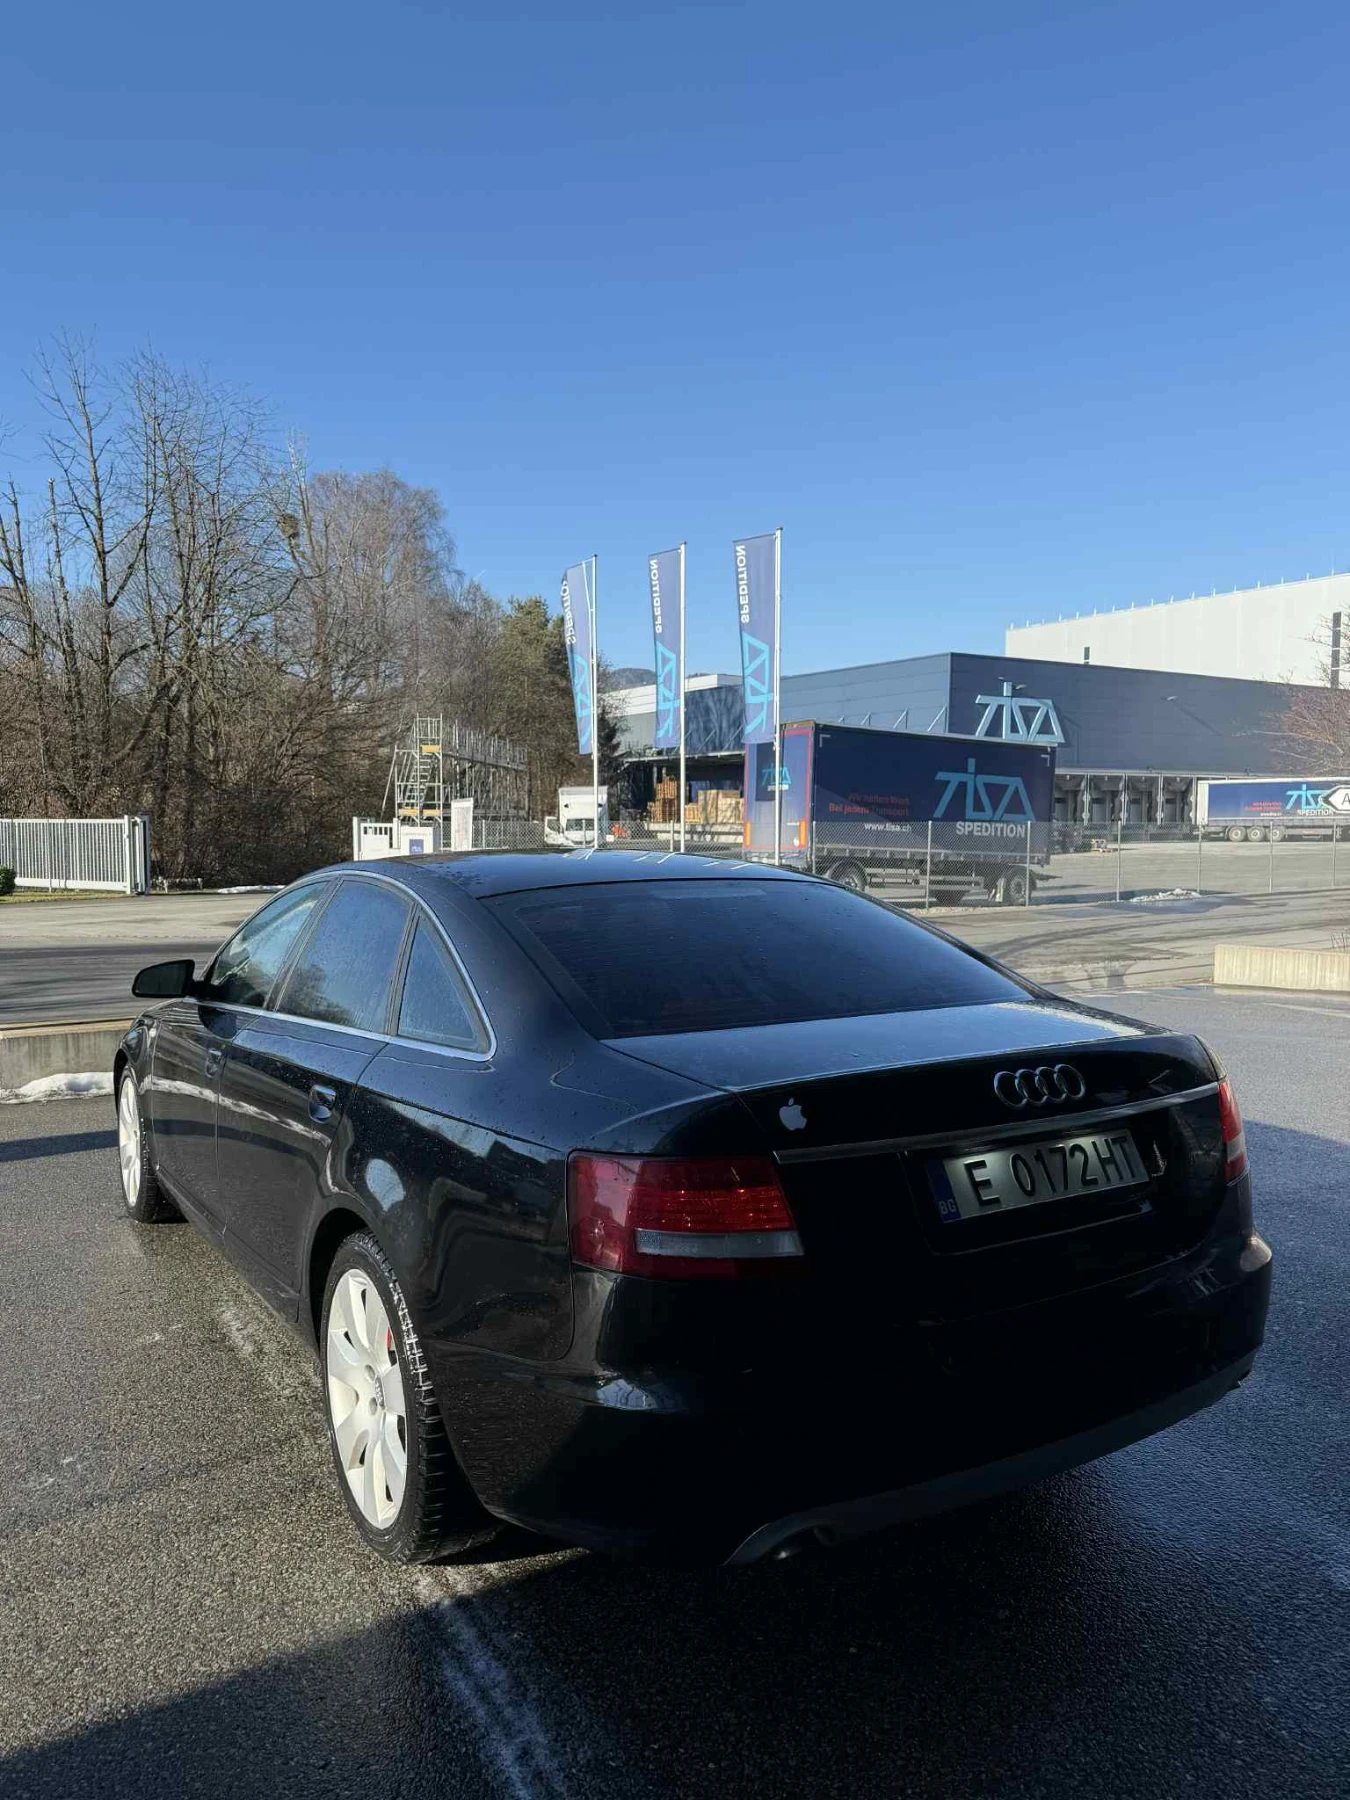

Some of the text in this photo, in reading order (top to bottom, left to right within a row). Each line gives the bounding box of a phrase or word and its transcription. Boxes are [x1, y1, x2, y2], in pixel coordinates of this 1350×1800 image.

[955, 821, 1026, 839] SPEDITION
[963, 1159, 1001, 1207] E
[938, 1199, 957, 1215] BG
